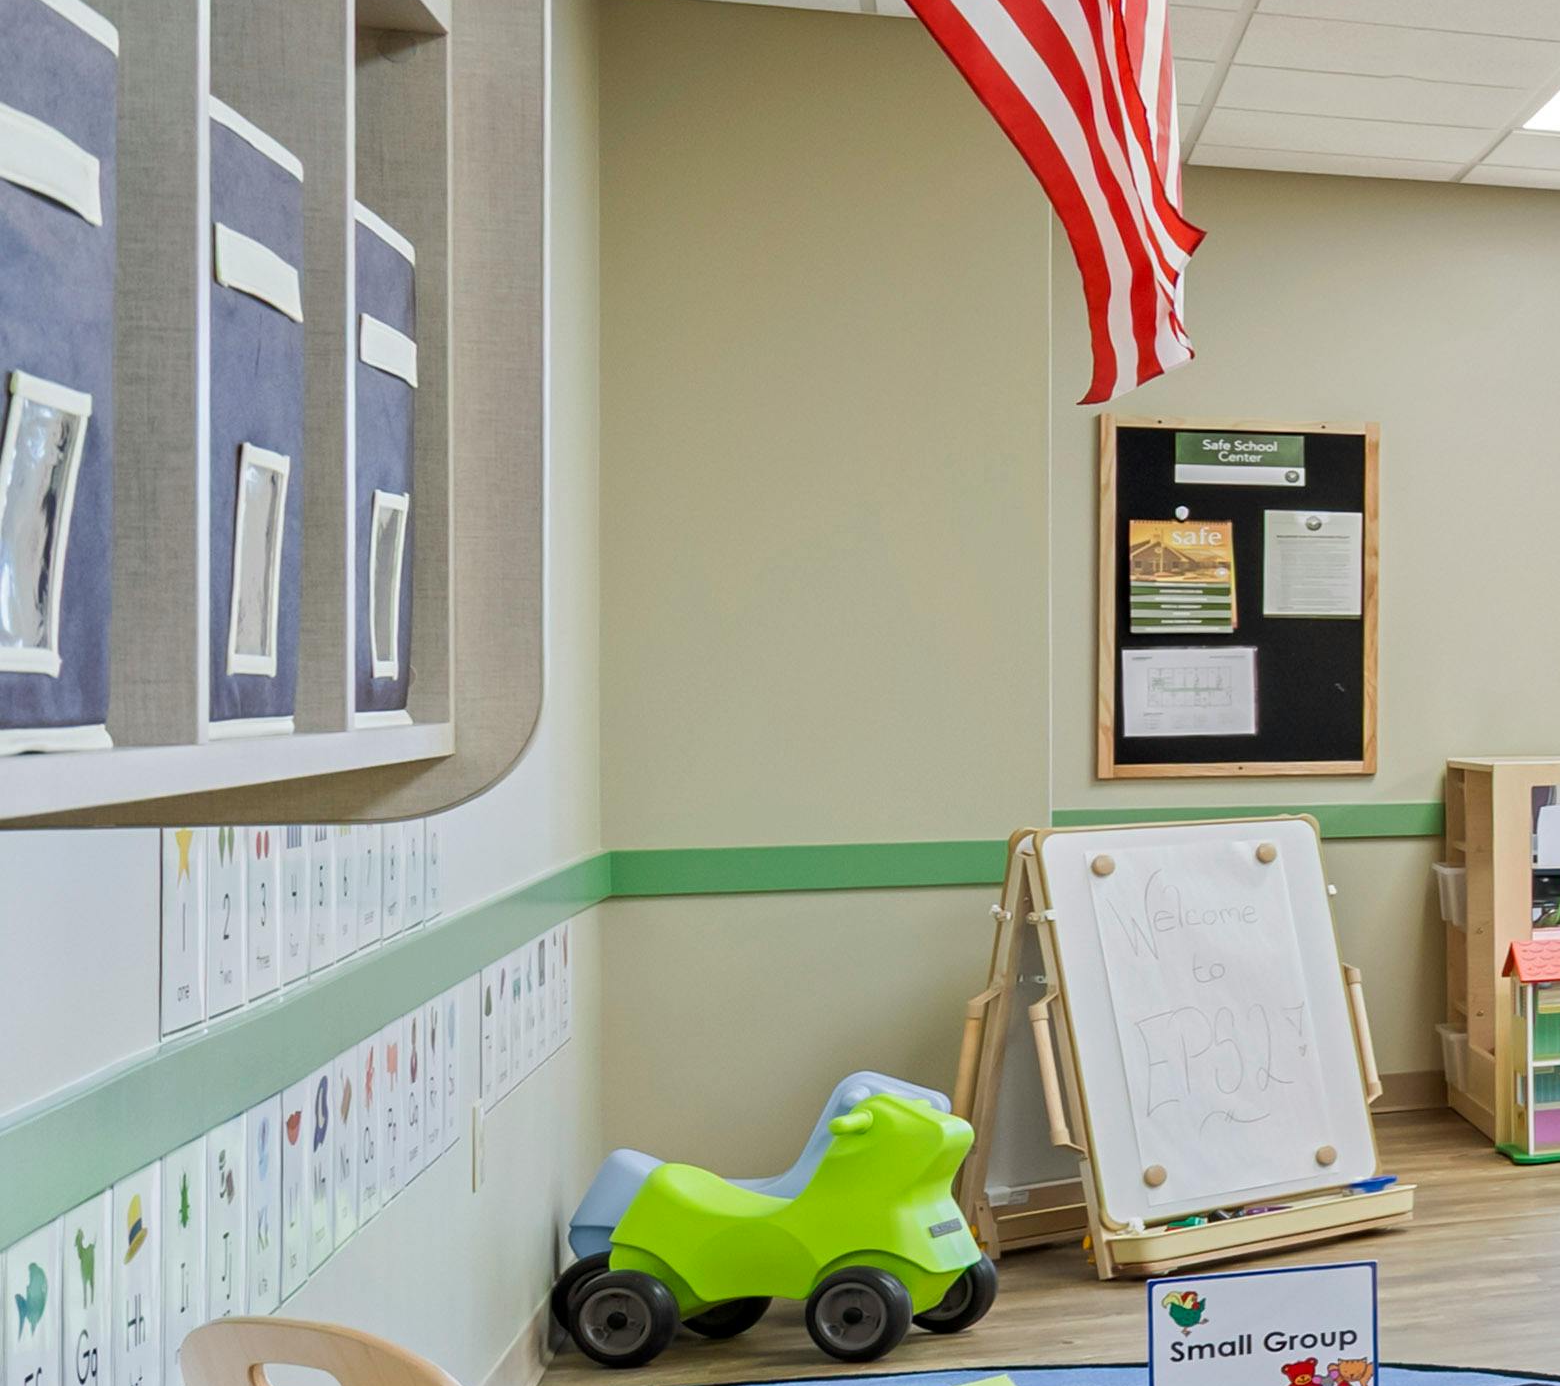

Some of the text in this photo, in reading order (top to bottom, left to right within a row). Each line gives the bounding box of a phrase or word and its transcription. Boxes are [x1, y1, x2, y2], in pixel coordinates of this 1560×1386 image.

[1202, 439, 1278, 453] Safe School
[1217, 451, 1262, 463] Center
[1171, 526, 1222, 546] safe
[221, 892, 232, 941] 2
[259, 882, 267, 927] 3
[1106, 867, 1259, 960] Welcome
[1192, 953, 1226, 983] to
[363, 1125, 375, 1164] Oo
[126, 1292, 146, 1354] Hh
[1169, 1329, 1358, 1362] Small Group
